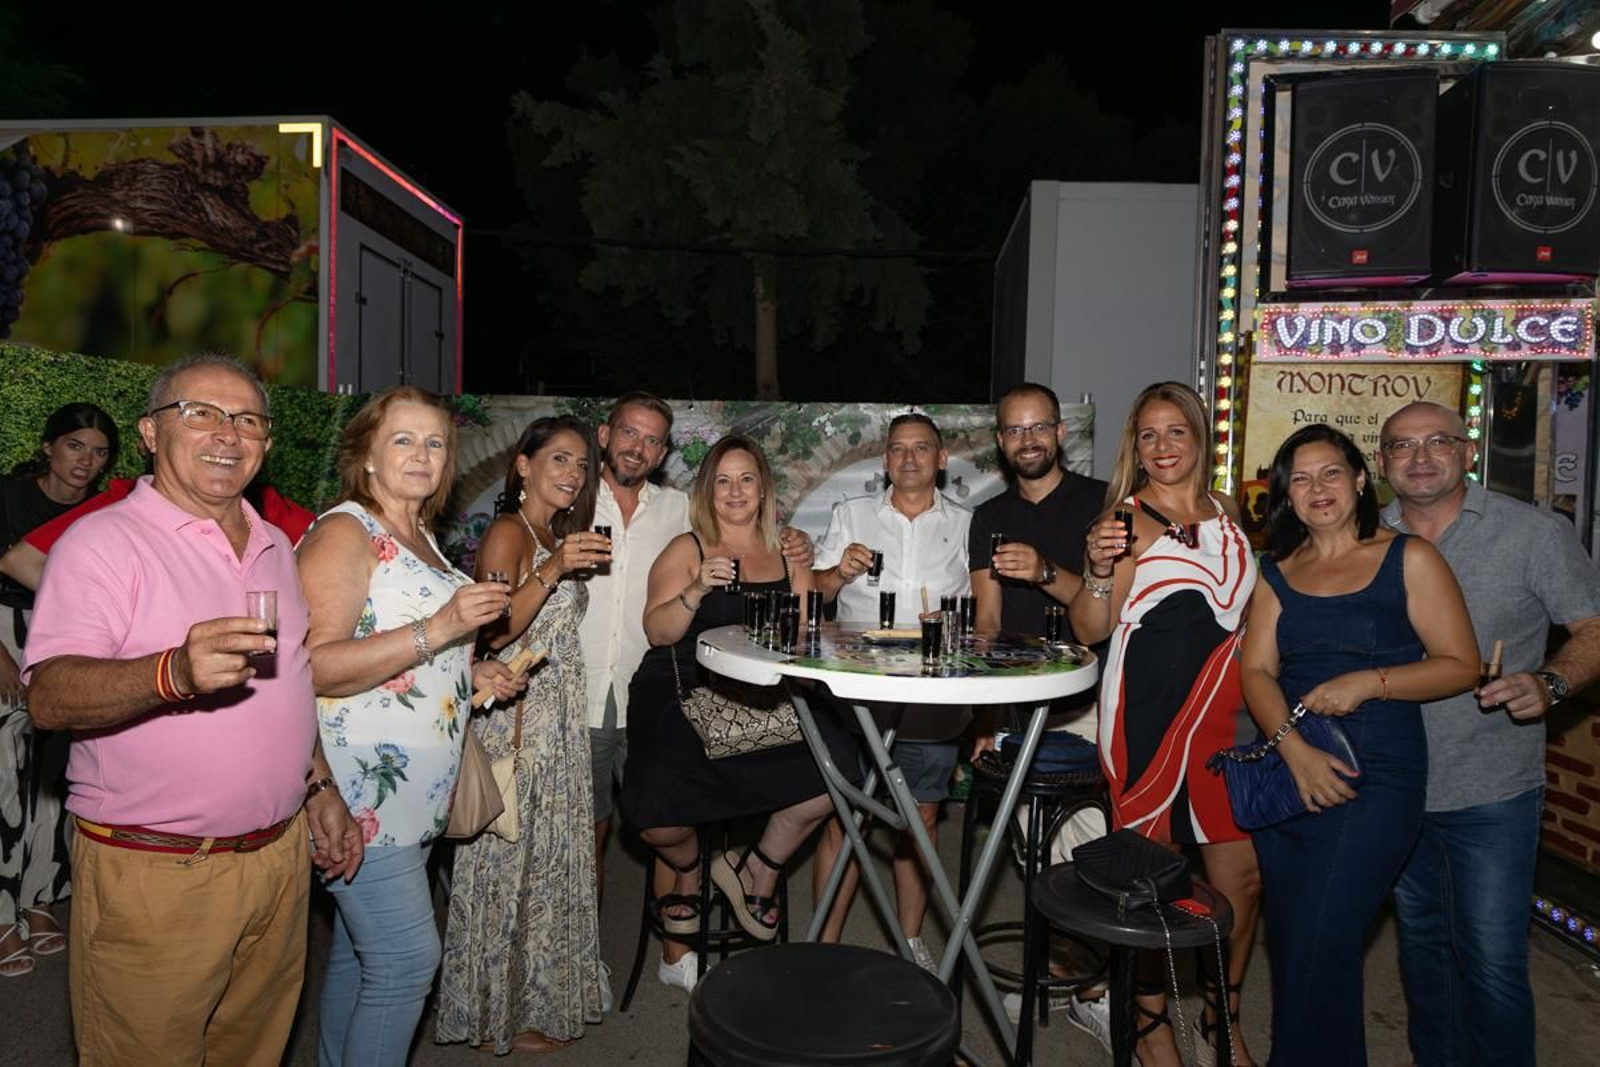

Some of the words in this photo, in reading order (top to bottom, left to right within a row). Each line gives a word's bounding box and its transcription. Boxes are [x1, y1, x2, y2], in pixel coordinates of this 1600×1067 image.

[1274, 314, 1389, 348] VINO
[1404, 312, 1580, 347] DULCE
[1292, 408, 1328, 425] Para
[1335, 412, 1361, 426] que
[1367, 412, 1379, 425] el
